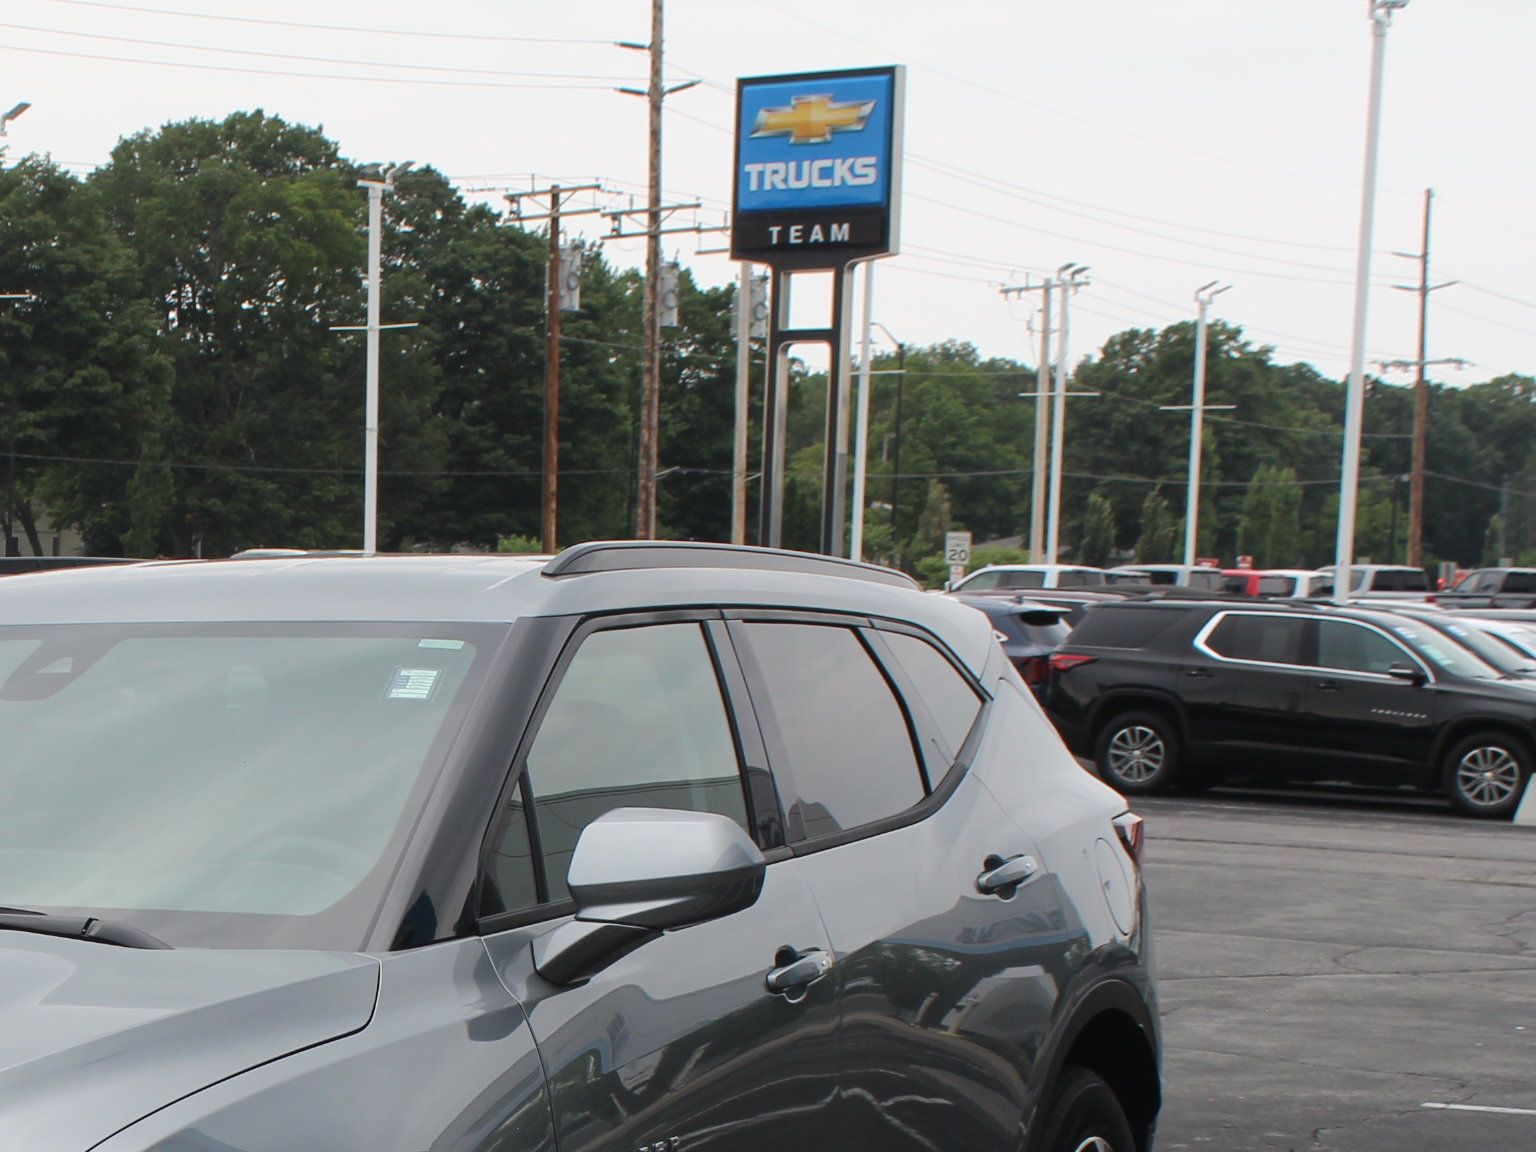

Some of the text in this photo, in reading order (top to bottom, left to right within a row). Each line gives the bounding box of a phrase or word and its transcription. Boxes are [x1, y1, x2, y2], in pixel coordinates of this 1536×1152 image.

[744, 156, 877, 192] TRUCKS
[768, 223, 850, 245] TEAM
[949, 549, 968, 561] 20
